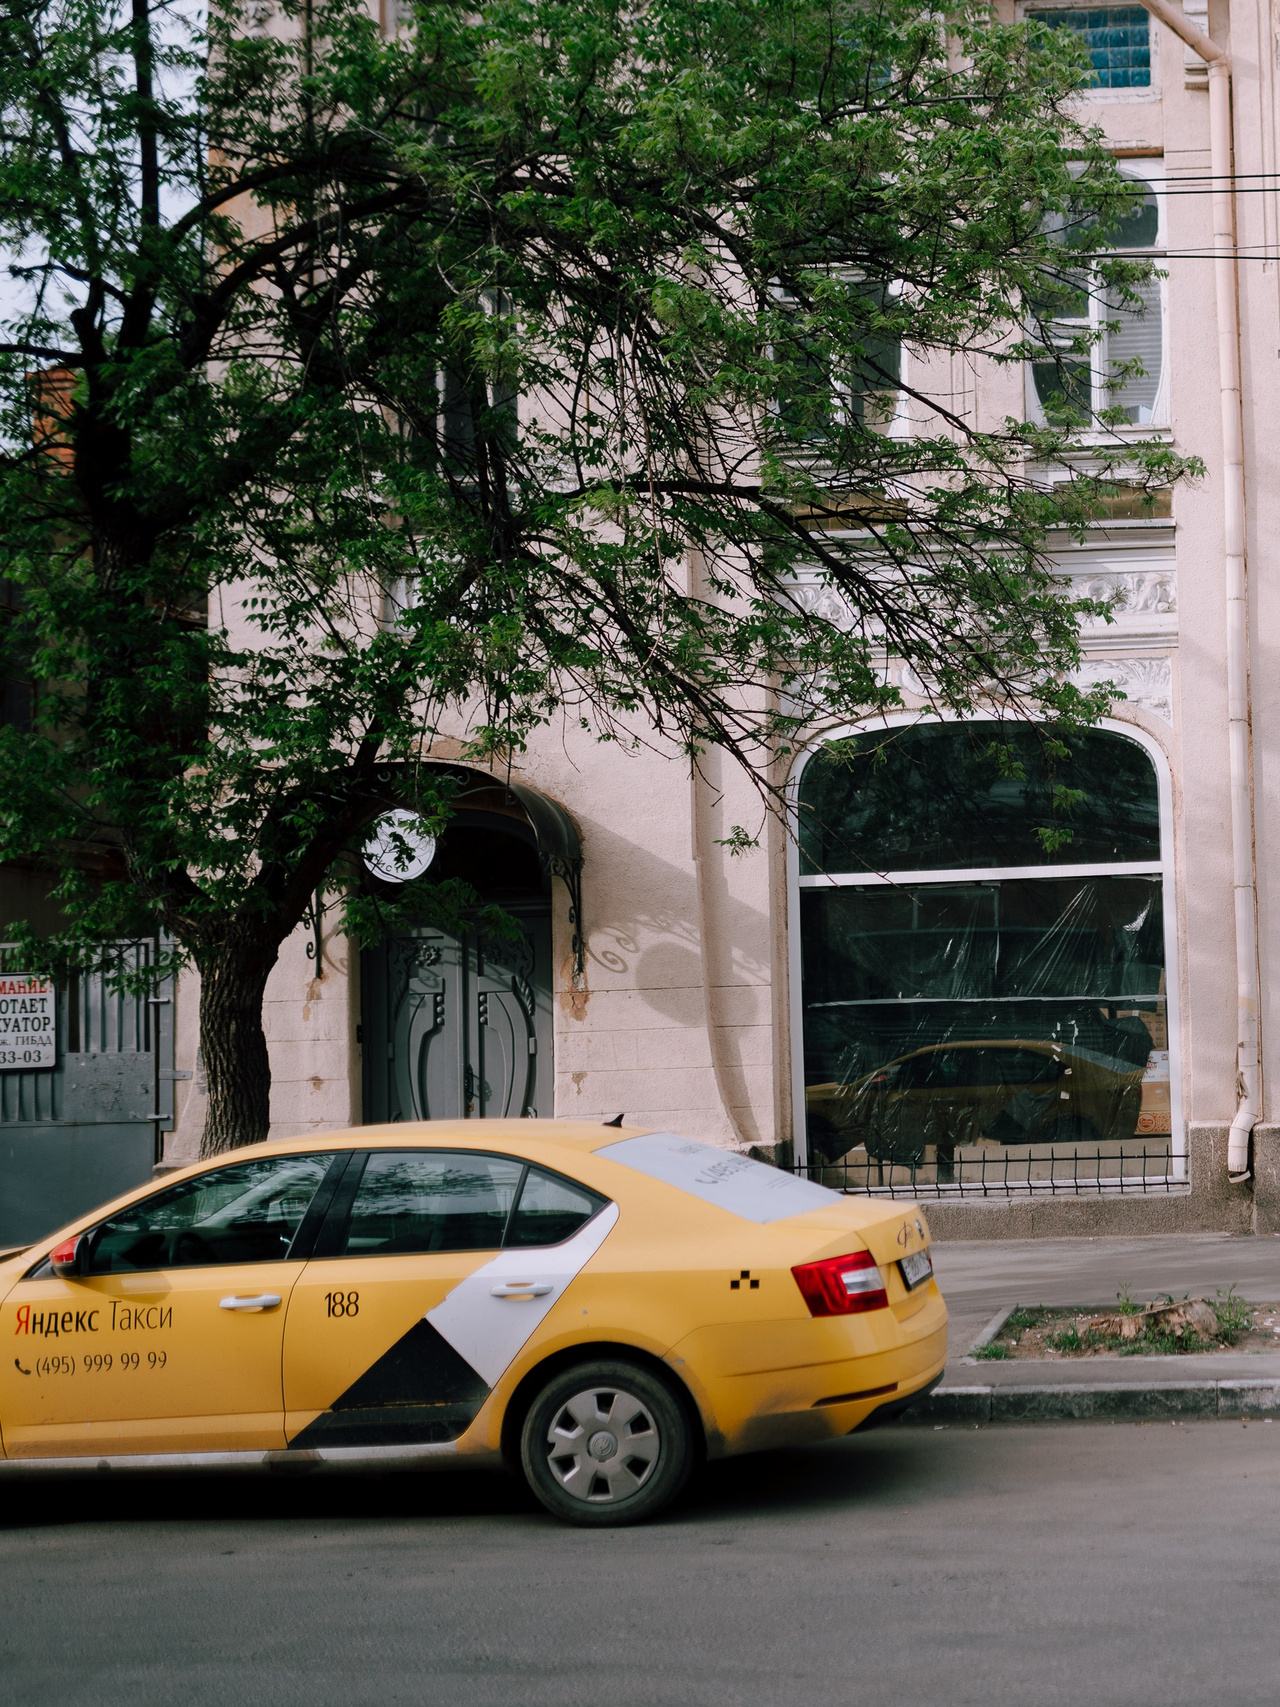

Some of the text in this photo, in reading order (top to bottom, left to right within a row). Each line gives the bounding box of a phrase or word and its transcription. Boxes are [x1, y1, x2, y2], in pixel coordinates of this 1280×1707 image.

[0, 1016, 55, 1033] УАТОР.
[15, 1035, 53, 1047] ГИБДД
[324, 1291, 359, 1318] 188
[14, 1300, 173, 1338] Яндекс Такси
[36, 1351, 168, 1378] (495) 999 99 99
